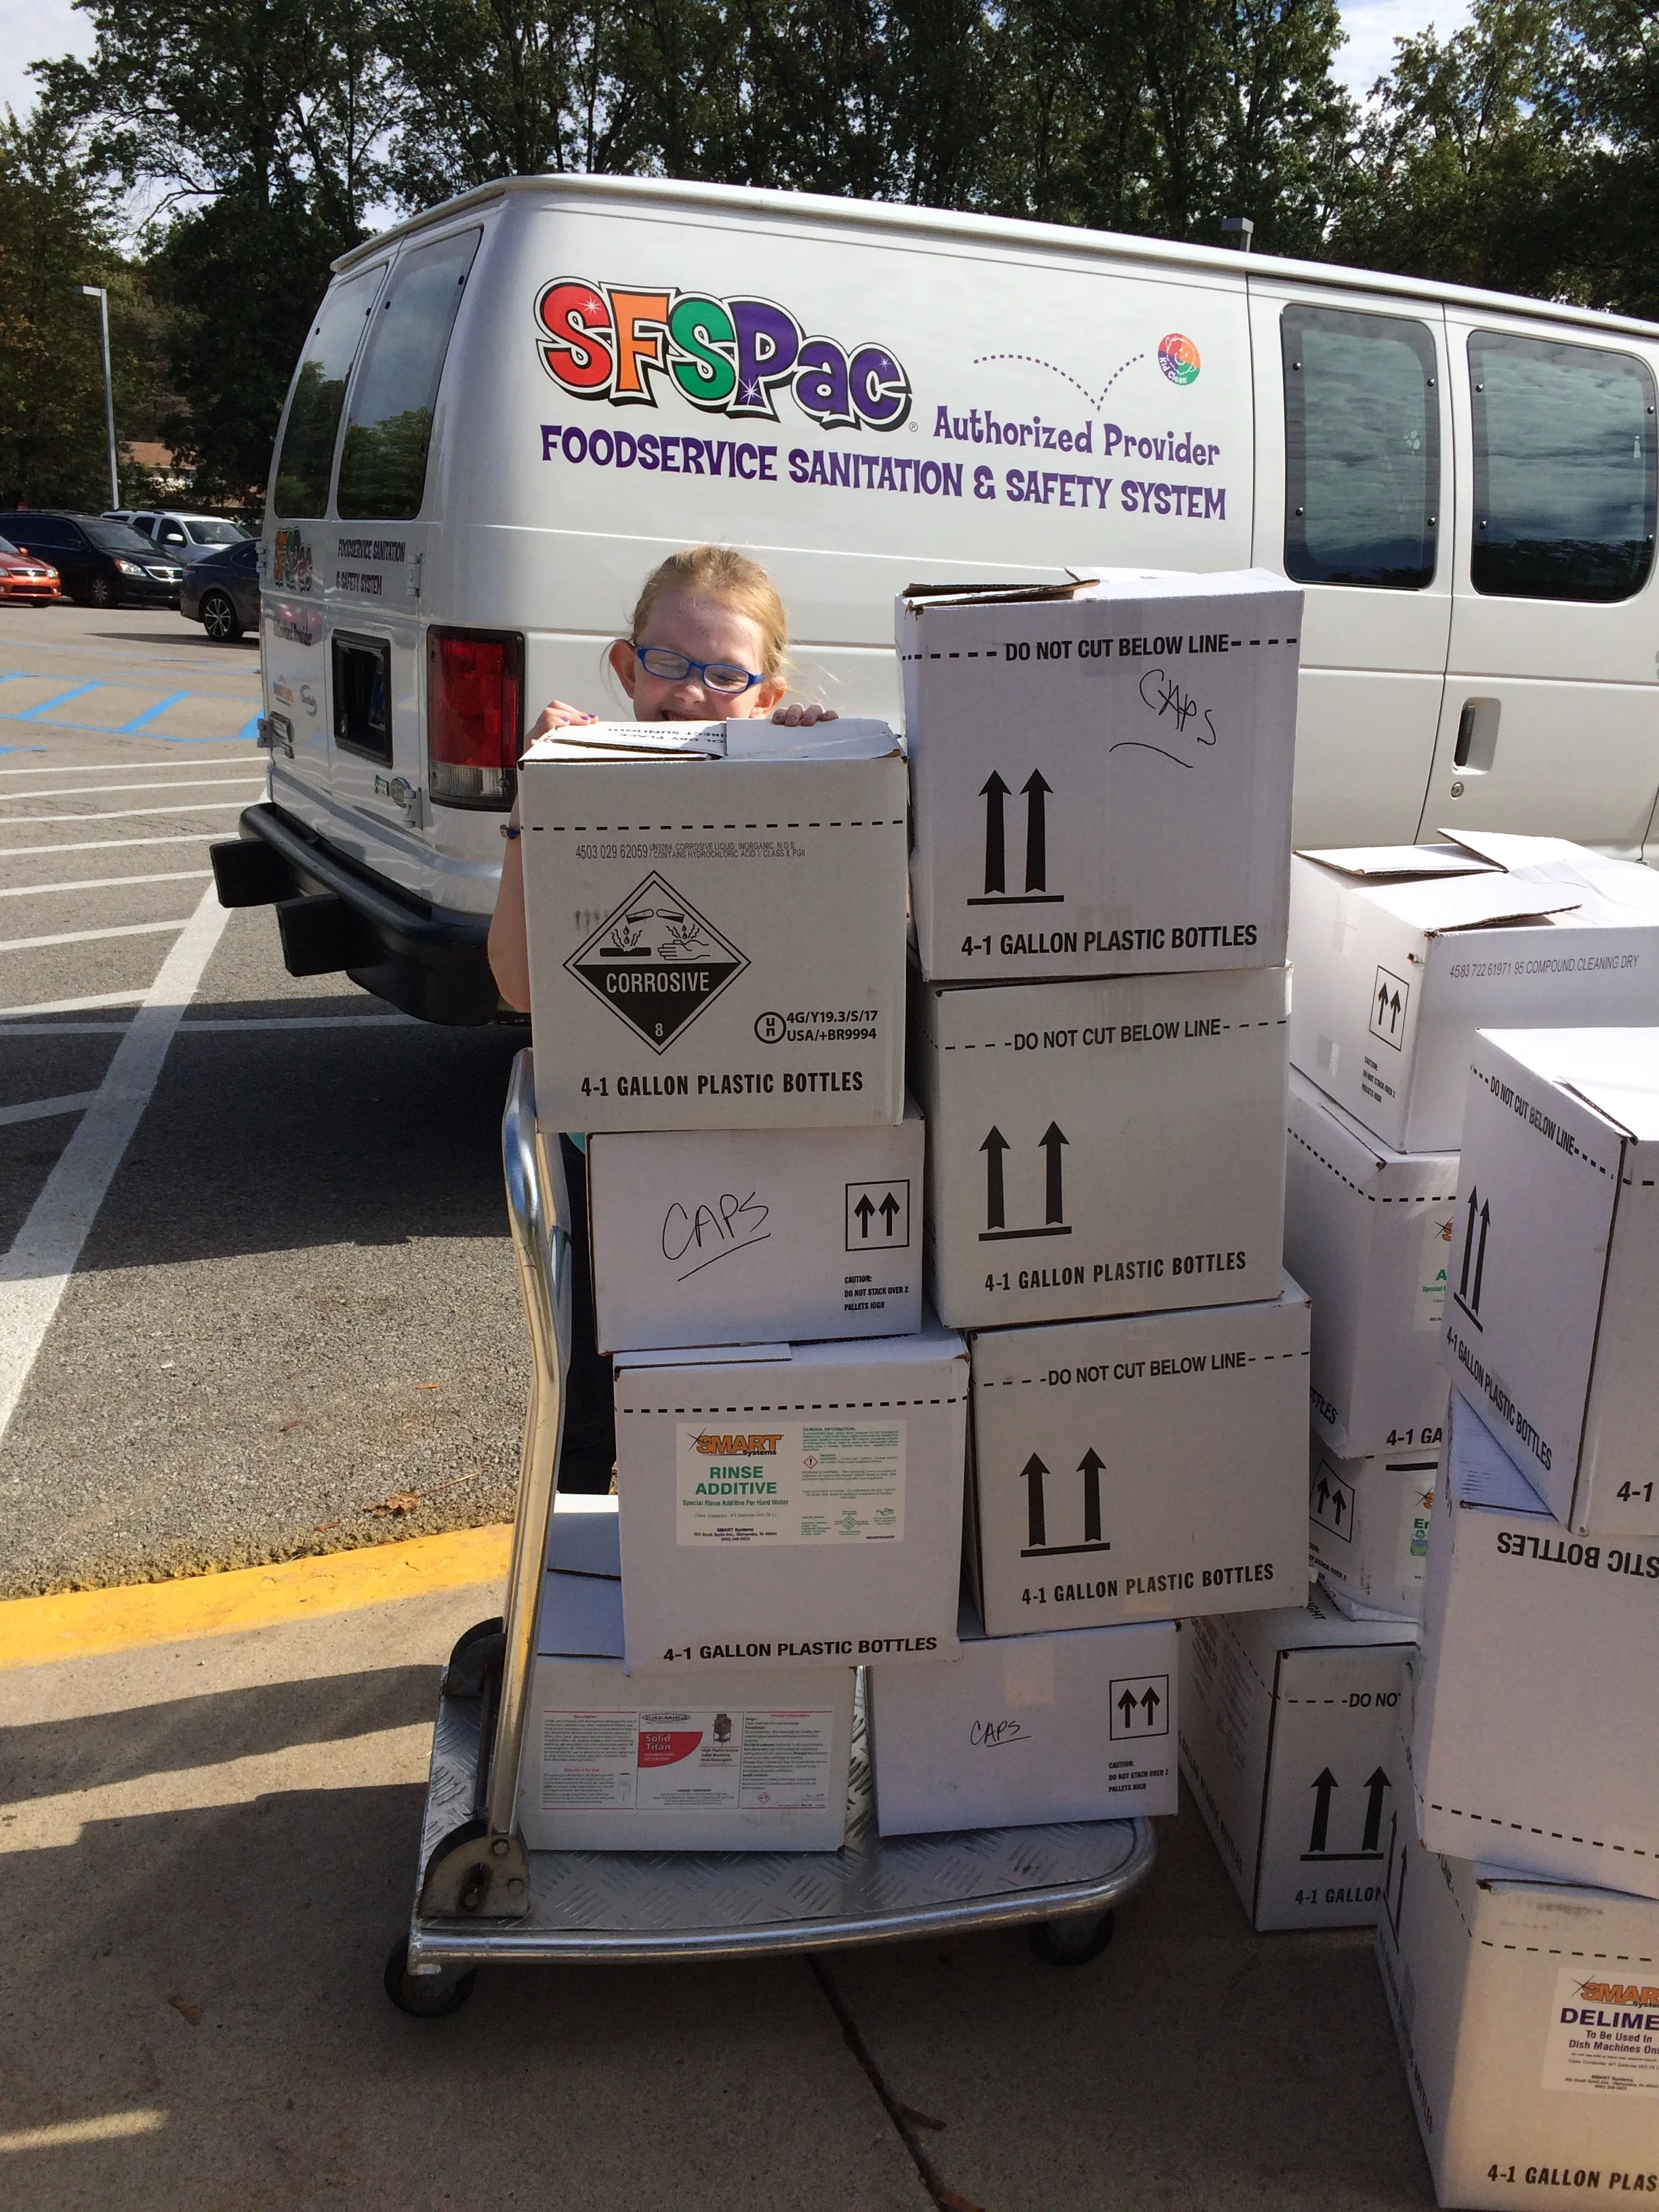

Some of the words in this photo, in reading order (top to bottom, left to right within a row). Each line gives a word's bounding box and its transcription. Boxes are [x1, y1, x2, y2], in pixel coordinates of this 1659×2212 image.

[533, 276, 912, 432] SFSPac
[1160, 357, 1170, 371] Kid
[1168, 371, 1187, 384] Clean
[933, 405, 1093, 454] Authorized
[1103, 423, 1220, 466] Provider
[540, 424, 777, 481] FOODSERVICE
[788, 447, 963, 497] SANITATION
[973, 465, 996, 500] &
[1006, 468, 1113, 510] SAFETY
[1121, 479, 1226, 520] SYSTEM
[337, 539, 372, 560] FOODSERVICE
[373, 541, 406, 562] SANITATION
[341, 573, 360, 592] SAFETY
[361, 575, 382, 595] SYSTEM
[1006, 642, 1031, 662] DO
[1036, 640, 1072, 660] NOT
[1077, 638, 1111, 659] CUT
[1118, 636, 1181, 657] BELOW
[1189, 634, 1229, 653] LINE
[576, 844, 598, 859] 4503
[600, 845, 617, 859] 029
[620, 844, 648, 859] 62059
[676, 842, 713, 851] CORROSIVE
[688, 850, 738, 859] HYDROCHLORIC
[763, 849, 784, 857] CLASS
[961, 935, 991, 956] 4-1
[1000, 932, 1078, 955] GALLON
[1084, 928, 1165, 952] PLASTIC
[1171, 924, 1257, 948] BOTTLES
[1450, 964, 1469, 978] 4583
[1471, 964, 1485, 977] 722
[1488, 962, 1511, 977] 61971
[1514, 962, 1524, 975] 95
[1620, 954, 1639, 968] DRY
[606, 971, 710, 993] CORROSIVE
[786, 1010, 878, 1024] 4G/Y19.3/S/17
[655, 1023, 663, 1037] 8
[787, 1027, 877, 1042] USA/+BR9994
[1014, 1032, 1038, 1051] DO
[1043, 1029, 1078, 1049] NOT
[1082, 1027, 1116, 1046] CUT
[1121, 1022, 1180, 1043] BELOW
[1184, 1019, 1221, 1038] LINE
[581, 1076, 609, 1097] 4-1
[617, 1075, 689, 1097] GALLON
[697, 1073, 774, 1094] PLASTIC
[783, 1071, 863, 1092] BOTTLES
[1490, 1075, 1499, 1097] DO
[1500, 1084, 1515, 1106] NOT
[1515, 1095, 1529, 1120] CUT
[1530, 1106, 1557, 1141] BELOW
[1557, 1126, 1575, 1156] LINE
[662, 1191, 769, 1260] CAPS
[844, 1275, 872, 1284] CAUTION:
[985, 1273, 1010, 1292] 4-1
[1019, 1266, 1085, 1290] GALLON
[1093, 1258, 1164, 1283] PLASTIC
[1172, 1251, 1246, 1275] BOTTLES
[867, 1288, 886, 1296] STACK
[888, 1286, 903, 1294] OVER
[844, 1302, 869, 1311] PALLETS
[1048, 1368, 1071, 1386] DO
[1076, 1365, 1109, 1384] NOT
[1113, 1361, 1145, 1380] CUT
[1150, 1355, 1206, 1377] BELOW
[1211, 1351, 1246, 1370] LINE
[1447, 1326, 1458, 1353] 4-1
[1458, 1339, 1483, 1388] GALLON
[1484, 1374, 1515, 1425] PLASTIC
[1516, 1411, 1552, 1471] BOTTLES
[697, 1435, 783, 1454] SMART
[1386, 1429, 1413, 1446] 4-1
[1421, 1428, 1442, 1444] GA
[710, 1466, 763, 1479] RINSE
[695, 1482, 777, 1495] ADDITIVE
[1616, 1481, 1653, 1502] 4-1
[1496, 1532, 1600, 1569] BOTTLES
[1607, 1550, 1659, 1579] STIC
[1021, 1587, 1046, 1605] 4-1
[1054, 1580, 1118, 1603] GALLON
[1126, 1573, 1194, 1595] PLASTIC
[1202, 1563, 1273, 1587] BOTTLES
[663, 1647, 691, 1661] 4-1
[699, 1643, 772, 1659] GALLON
[777, 1640, 853, 1656] PLASTIC
[858, 1637, 937, 1654] BOTTLES
[1349, 1692, 1372, 1707] DO
[1376, 1692, 1401, 1707] NO
[646, 1734, 670, 1742] Solid
[970, 1720, 1021, 1746] CAPS
[1108, 1761, 1134, 1769] CAUTION:
[1131, 1771, 1149, 1779] STACK
[1149, 1769, 1164, 1778] OVER
[1108, 1784, 1132, 1793] PALLETS
[1295, 1889, 1317, 1904] 4-1
[1581, 1982, 1659, 2004] SMAR
[1560, 2007, 1659, 2031] DELIME
[1569, 2040, 1591, 2049] Dish
[1593, 2041, 1641, 2054] Machines
[1644, 2045, 1659, 2055] Onl
[1586, 2030, 1597, 2039] To
[1599, 2031, 1612, 2040] Be
[1616, 2032, 1640, 2043] Used
[1487, 2164, 1516, 2184] 4-1
[1525, 2167, 1600, 2189] GALLON
[1608, 2171, 1658, 2192] PLAS
